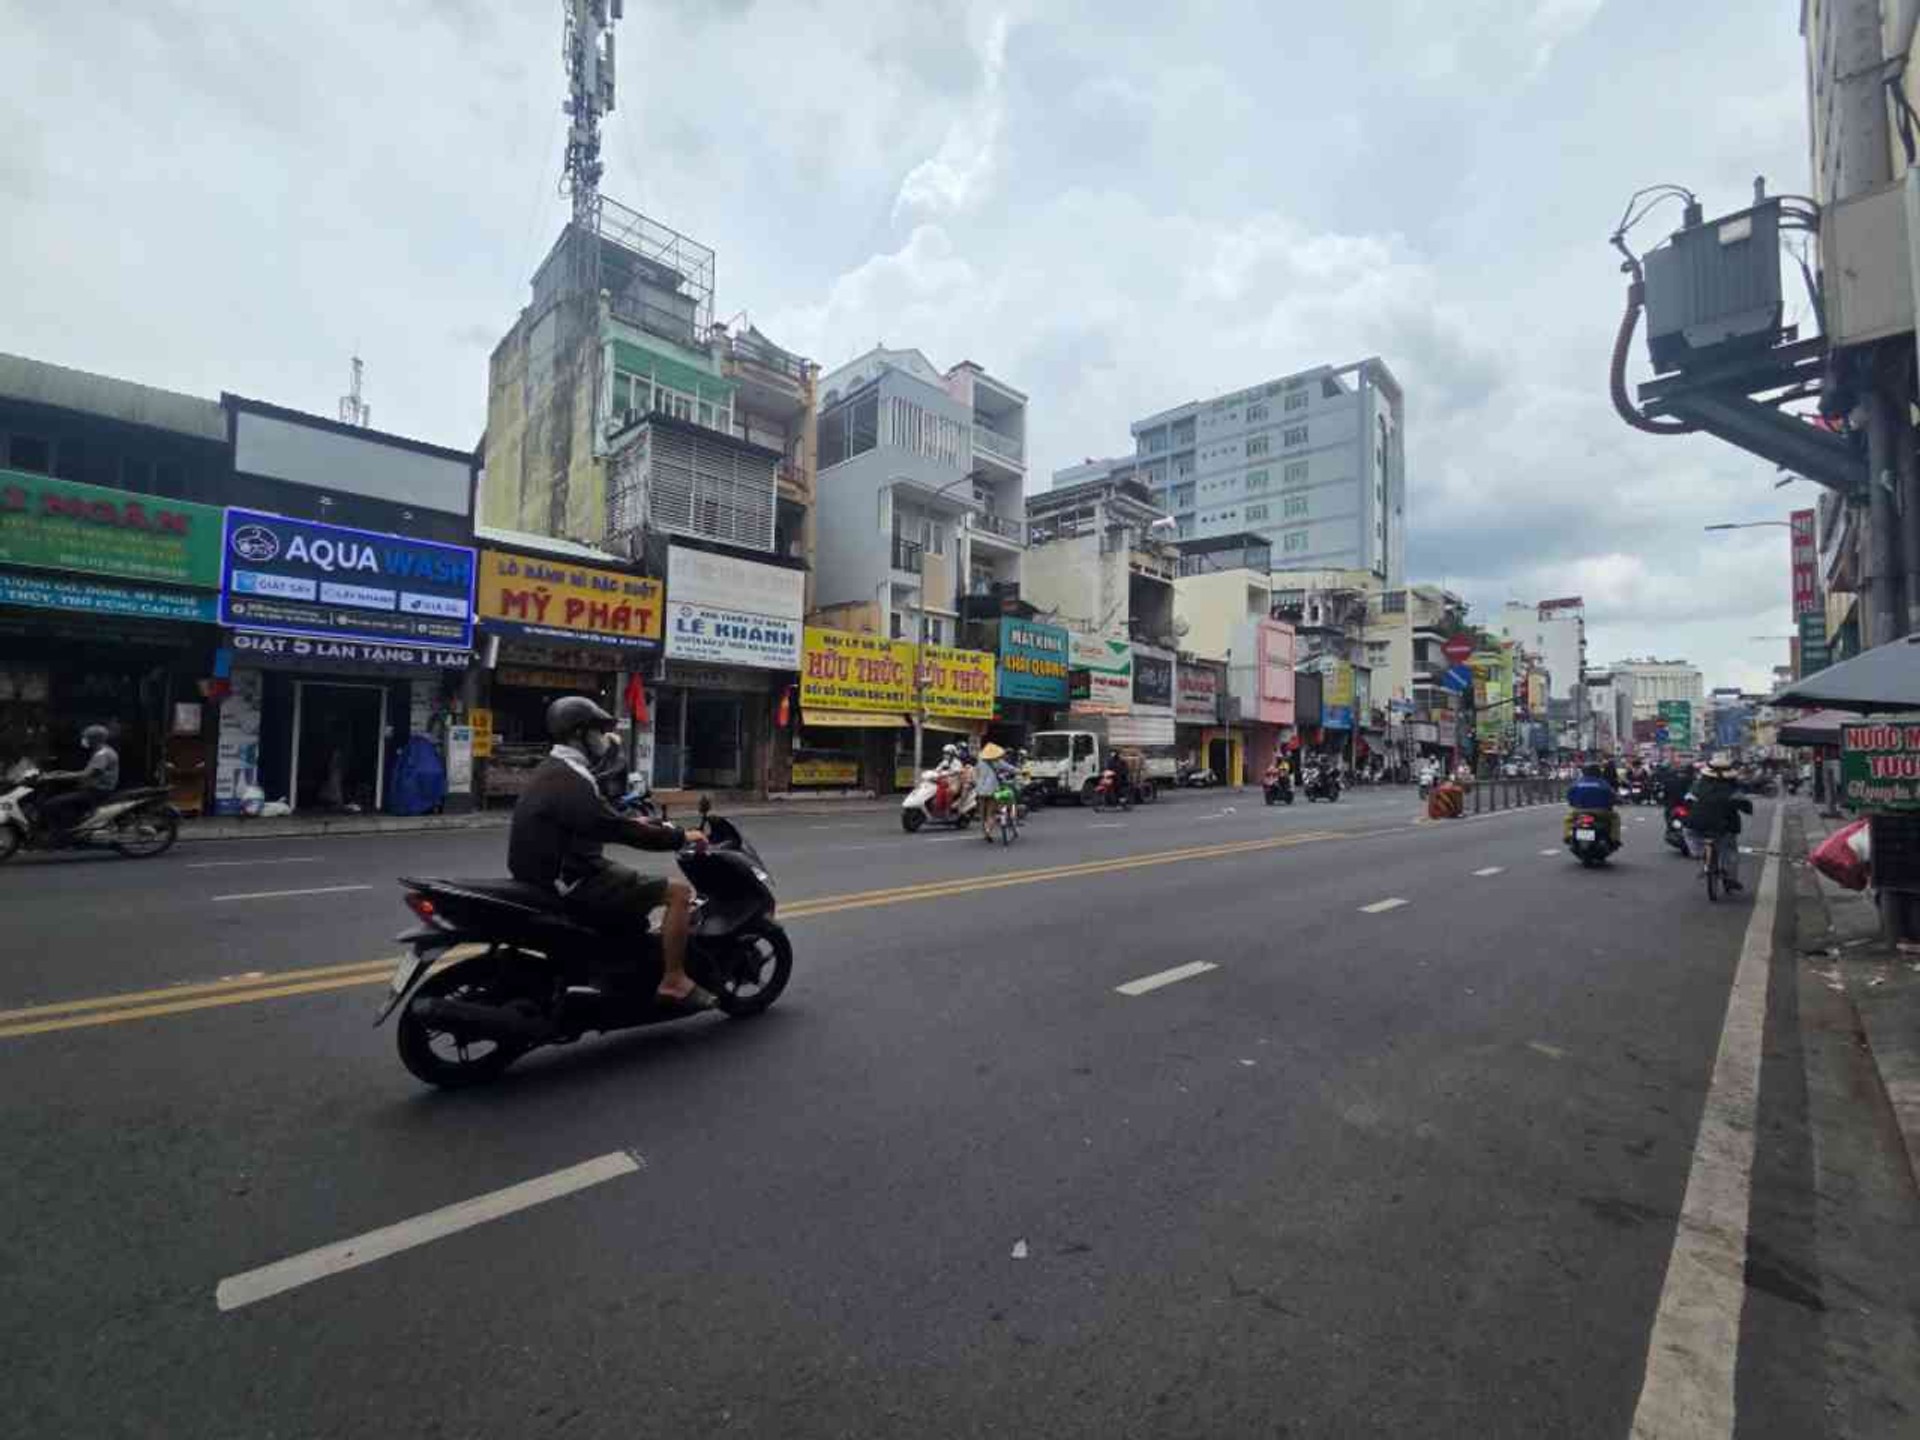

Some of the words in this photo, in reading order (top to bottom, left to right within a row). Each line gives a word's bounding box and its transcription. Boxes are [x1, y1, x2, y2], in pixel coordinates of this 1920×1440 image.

[285, 535, 379, 573] AQUA
[383, 549, 469, 586] WASH
[501, 585, 553, 622] MỸ
[564, 598, 653, 634] PHÁT
[293, 640, 312, 653] 5
[421, 651, 430, 664] 1
